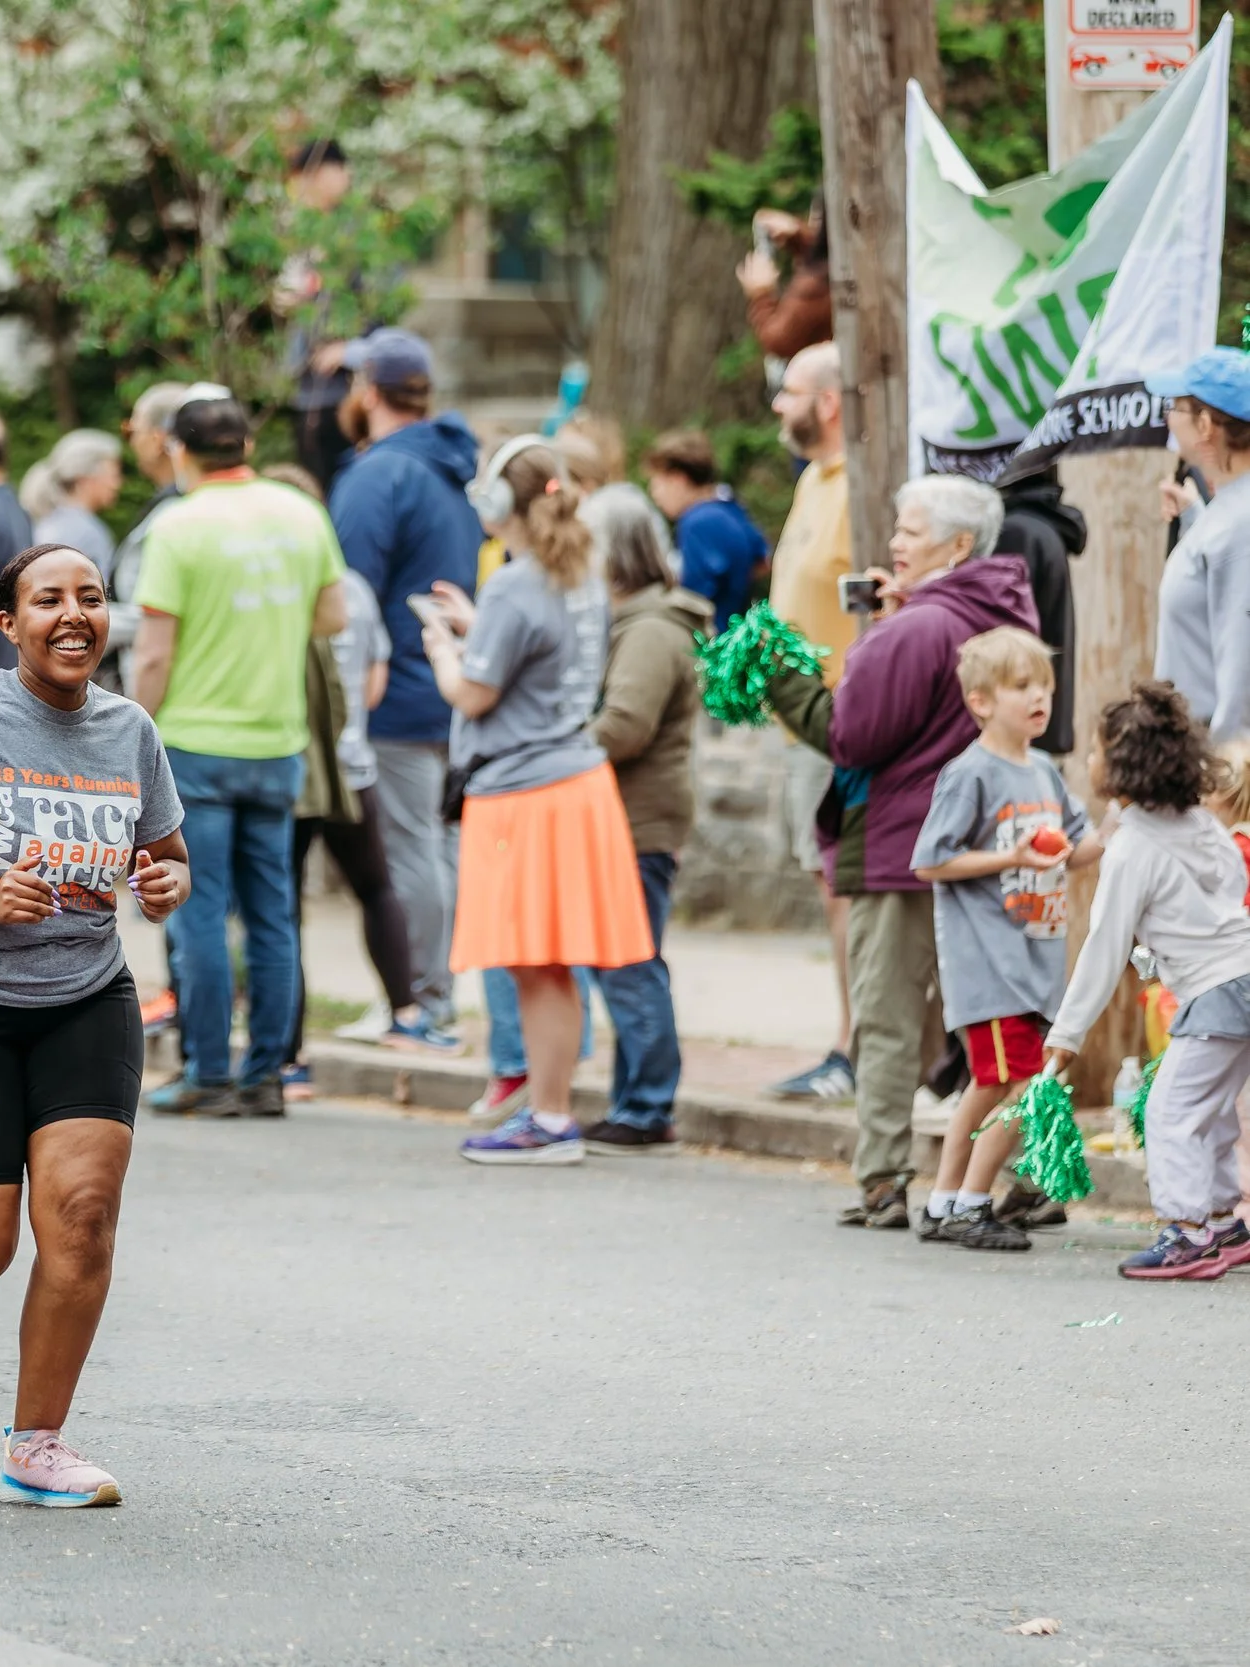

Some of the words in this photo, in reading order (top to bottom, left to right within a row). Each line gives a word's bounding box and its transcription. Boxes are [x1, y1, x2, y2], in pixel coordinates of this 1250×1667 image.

[1087, 9, 1176, 30] DECLARED
[19, 768, 70, 789] Years
[73, 774, 141, 798] Running
